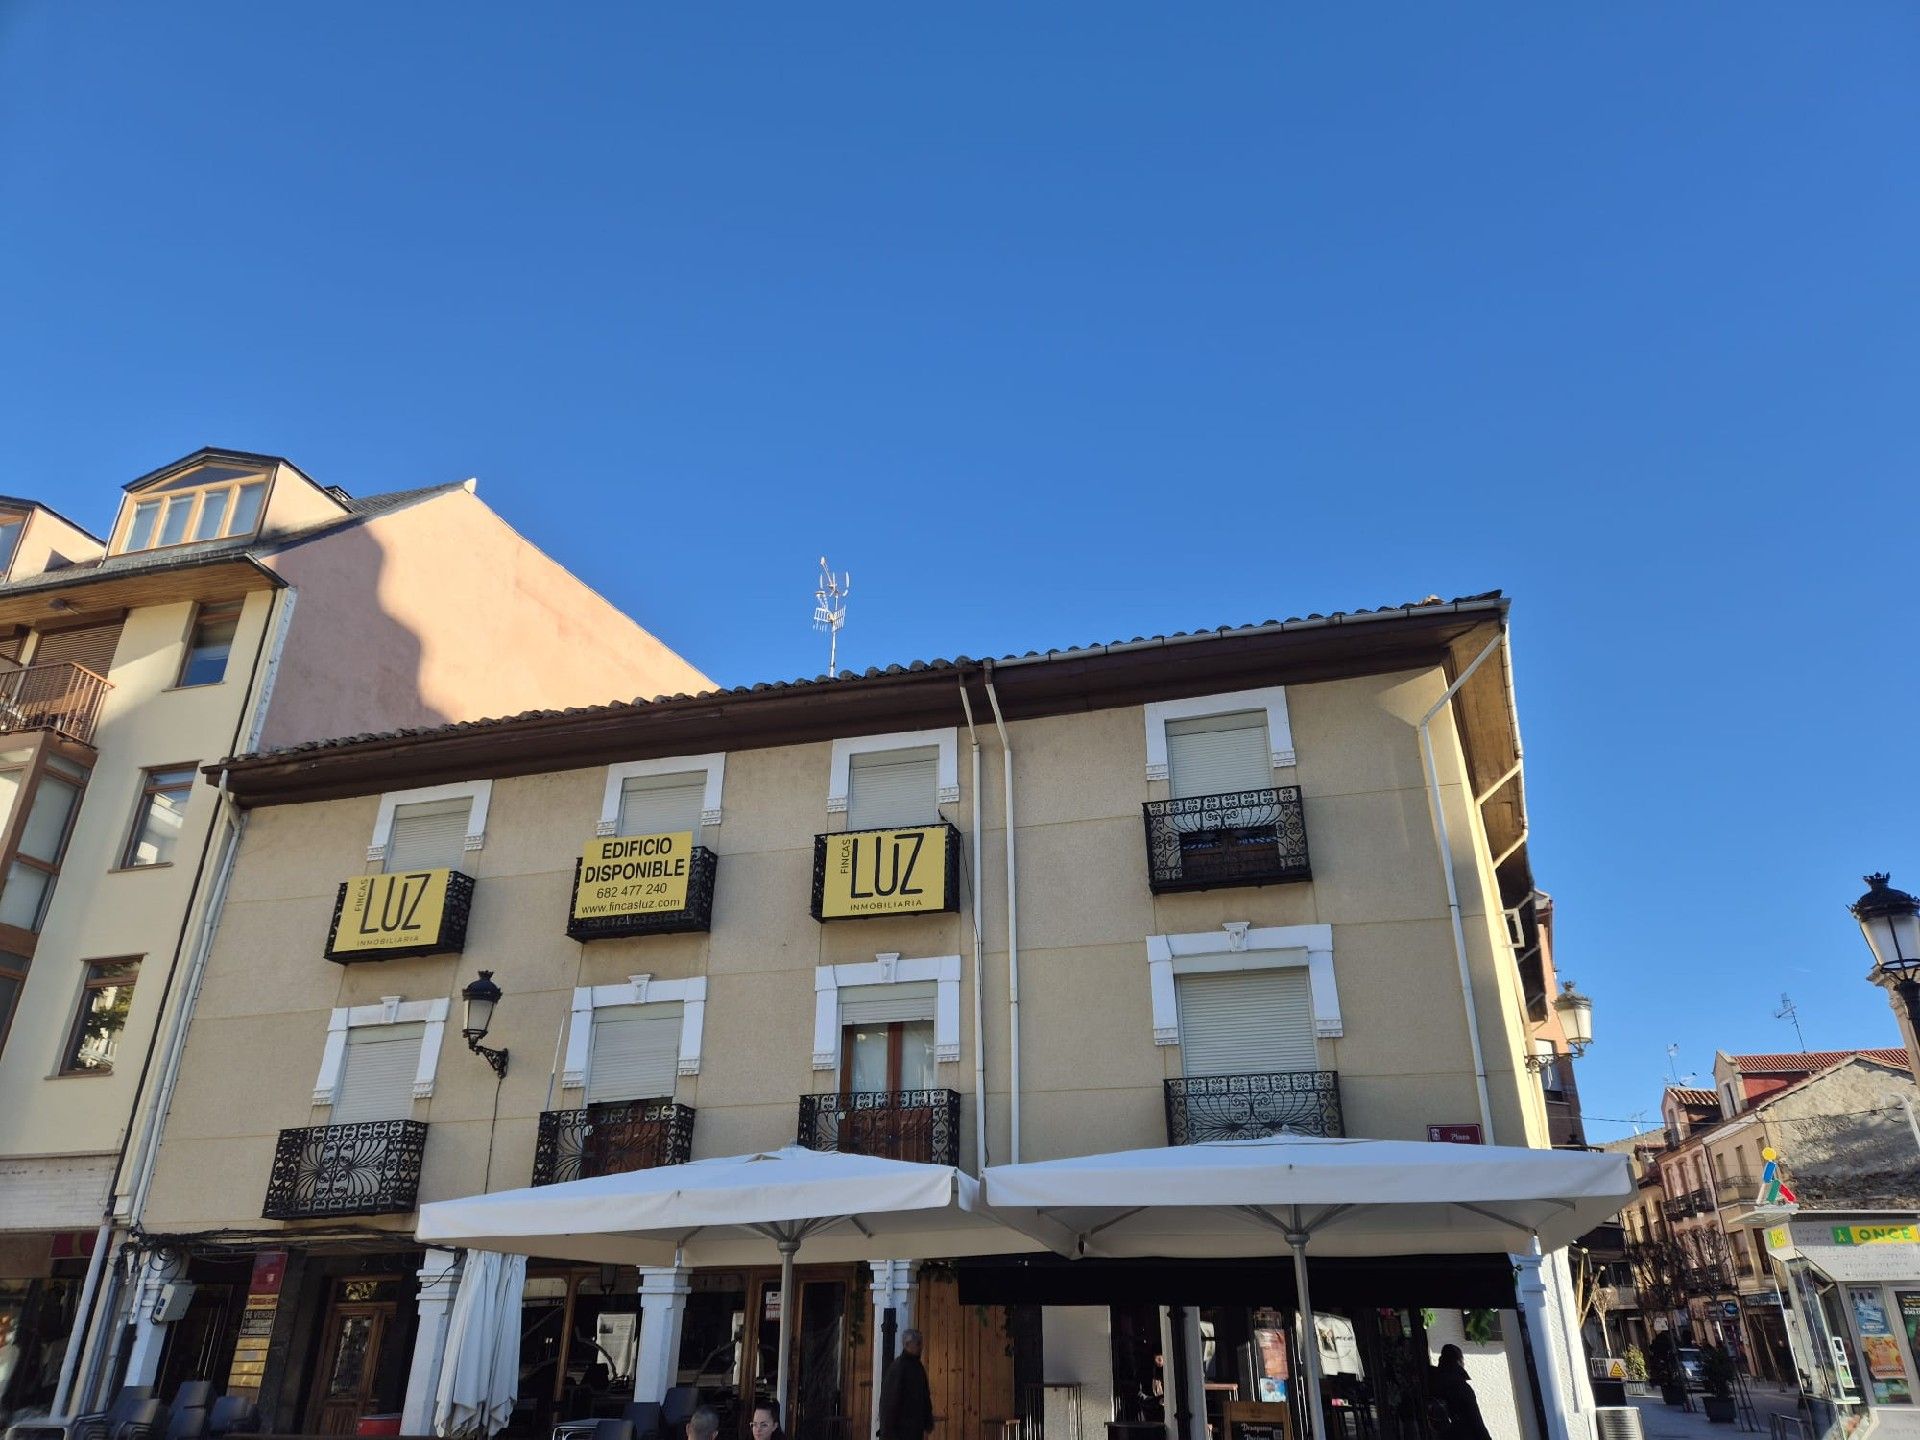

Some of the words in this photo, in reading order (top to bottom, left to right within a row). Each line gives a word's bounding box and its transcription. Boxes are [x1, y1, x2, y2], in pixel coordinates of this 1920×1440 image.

[601, 837, 673, 860] EDIFICIO
[841, 838, 851, 874] FINCAS
[584, 858, 686, 884] DISPONIBLE
[851, 832, 924, 899] LUZ
[354, 878, 369, 912] FINCAS
[596, 887, 618, 899] 682
[620, 885, 643, 897] 477
[646, 883, 668, 895] 240
[360, 873, 432, 935] LUZ
[581, 898, 681, 914] www.fincasluz.com
[850, 899, 923, 911] INMOBILIARIA
[357, 936, 420, 948] INMOBILIARIA
[1858, 1225, 1913, 1241] ONCE
